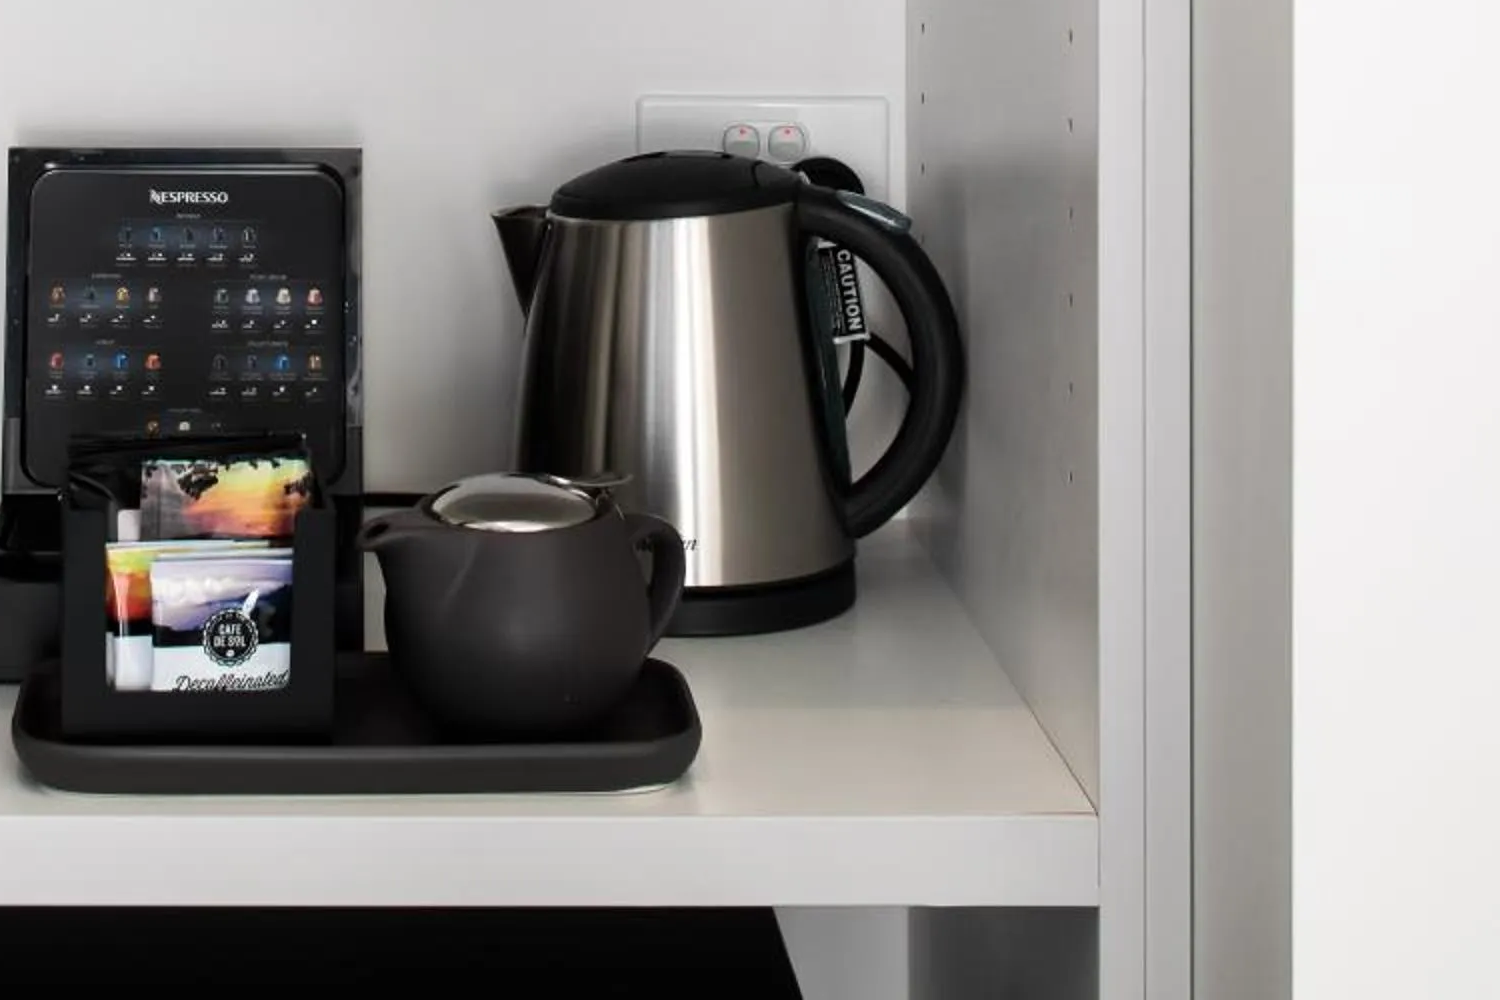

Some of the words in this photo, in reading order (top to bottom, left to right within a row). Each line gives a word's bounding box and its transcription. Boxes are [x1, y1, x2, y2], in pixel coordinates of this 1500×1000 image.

[149, 189, 229, 205] NESPRESSO
[837, 248, 863, 331] CAUTION
[218, 623, 241, 635] CAFE
